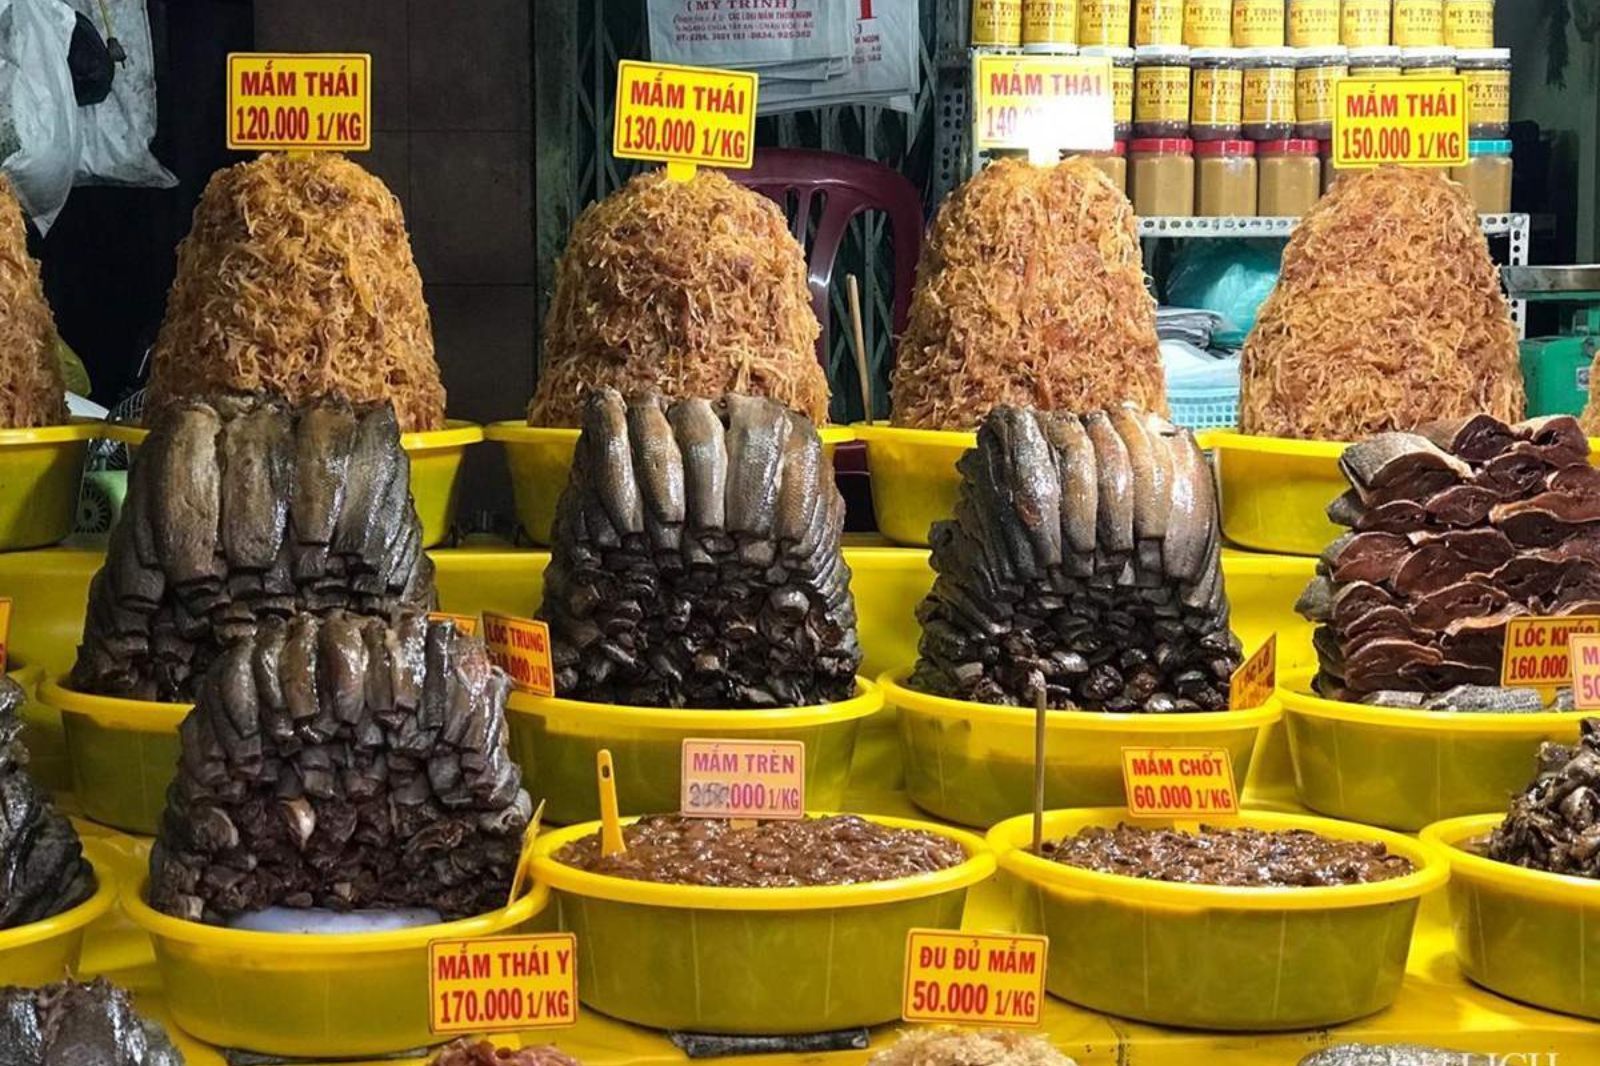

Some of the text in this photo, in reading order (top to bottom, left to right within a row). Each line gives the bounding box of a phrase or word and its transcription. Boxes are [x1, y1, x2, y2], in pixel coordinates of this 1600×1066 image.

[240, 60, 358, 97] MẮM THÁI
[630, 71, 745, 115] MẮM THÁI
[991, 62, 1101, 96] MẮM THÁI
[1346, 83, 1398, 118] MẮM
[1405, 86, 1456, 117] THÁI
[236, 105, 362, 141] 120.000 1/KG
[623, 114, 746, 159] 130.000 1/KG
[1342, 126, 1460, 160] 150.000 1/KG
[1514, 621, 1546, 649] LÓC
[1509, 654, 1569, 680] 160.000
[693, 743, 795, 774] MẮM TRÈN
[1178, 749, 1223, 777] CHỐT
[768, 786, 800, 810] 1/KG
[1133, 784, 1232, 809] 60.000 1/KG
[438, 941, 570, 981] MẮM THÁI Y
[919, 939, 1036, 976] ĐU ĐỦ MẮM
[440, 987, 570, 1024] 170.000 1/KG
[912, 980, 1036, 1018] 50.000 1/KG
